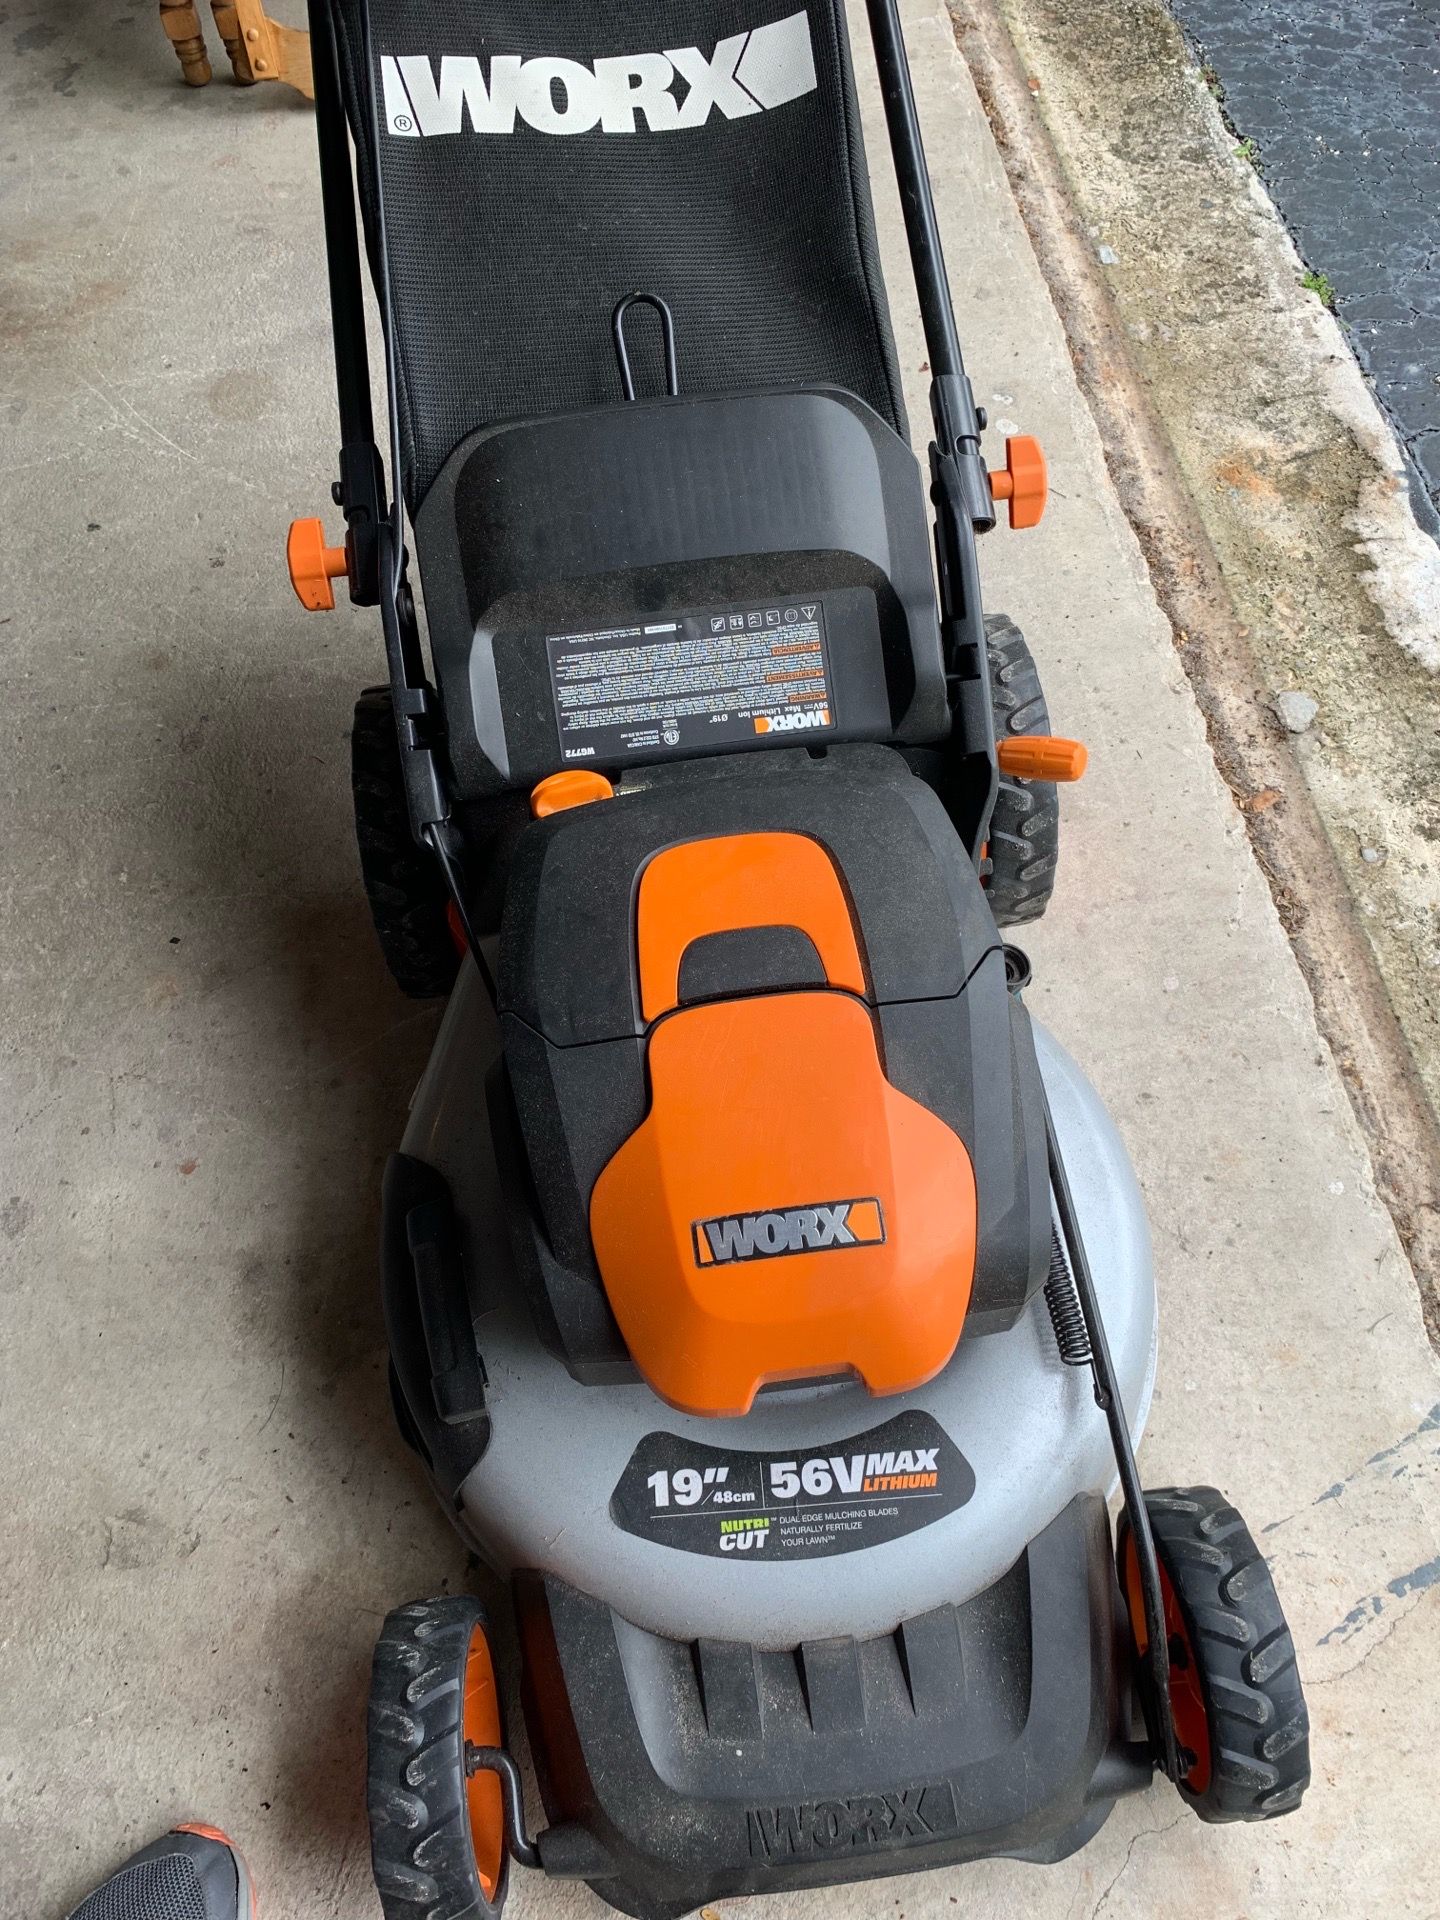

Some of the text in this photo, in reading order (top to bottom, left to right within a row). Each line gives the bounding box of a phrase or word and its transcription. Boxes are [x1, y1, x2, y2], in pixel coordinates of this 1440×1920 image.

[397, 31, 764, 137] WORX
[768, 672, 817, 681] AVERTISSEMENT
[791, 693, 820, 701] WARNING
[737, 709, 751, 718] Ion
[752, 707, 781, 716] Lithium
[768, 710, 825, 730] WORX
[565, 747, 595, 758] WG772
[706, 1204, 856, 1261] WORX
[865, 1448, 940, 1477] MAX
[769, 1455, 866, 1499] 56V
[863, 1473, 938, 1492] LITHIUM
[779, 1507, 899, 1525] DUAL EDGE MULCHING BLADES
[780, 1521, 863, 1535] NATURALLY FERTILIZE
[719, 1530, 770, 1551] CUT
[781, 1536, 804, 1547] YOUR
[753, 1788, 934, 1857] WORX
